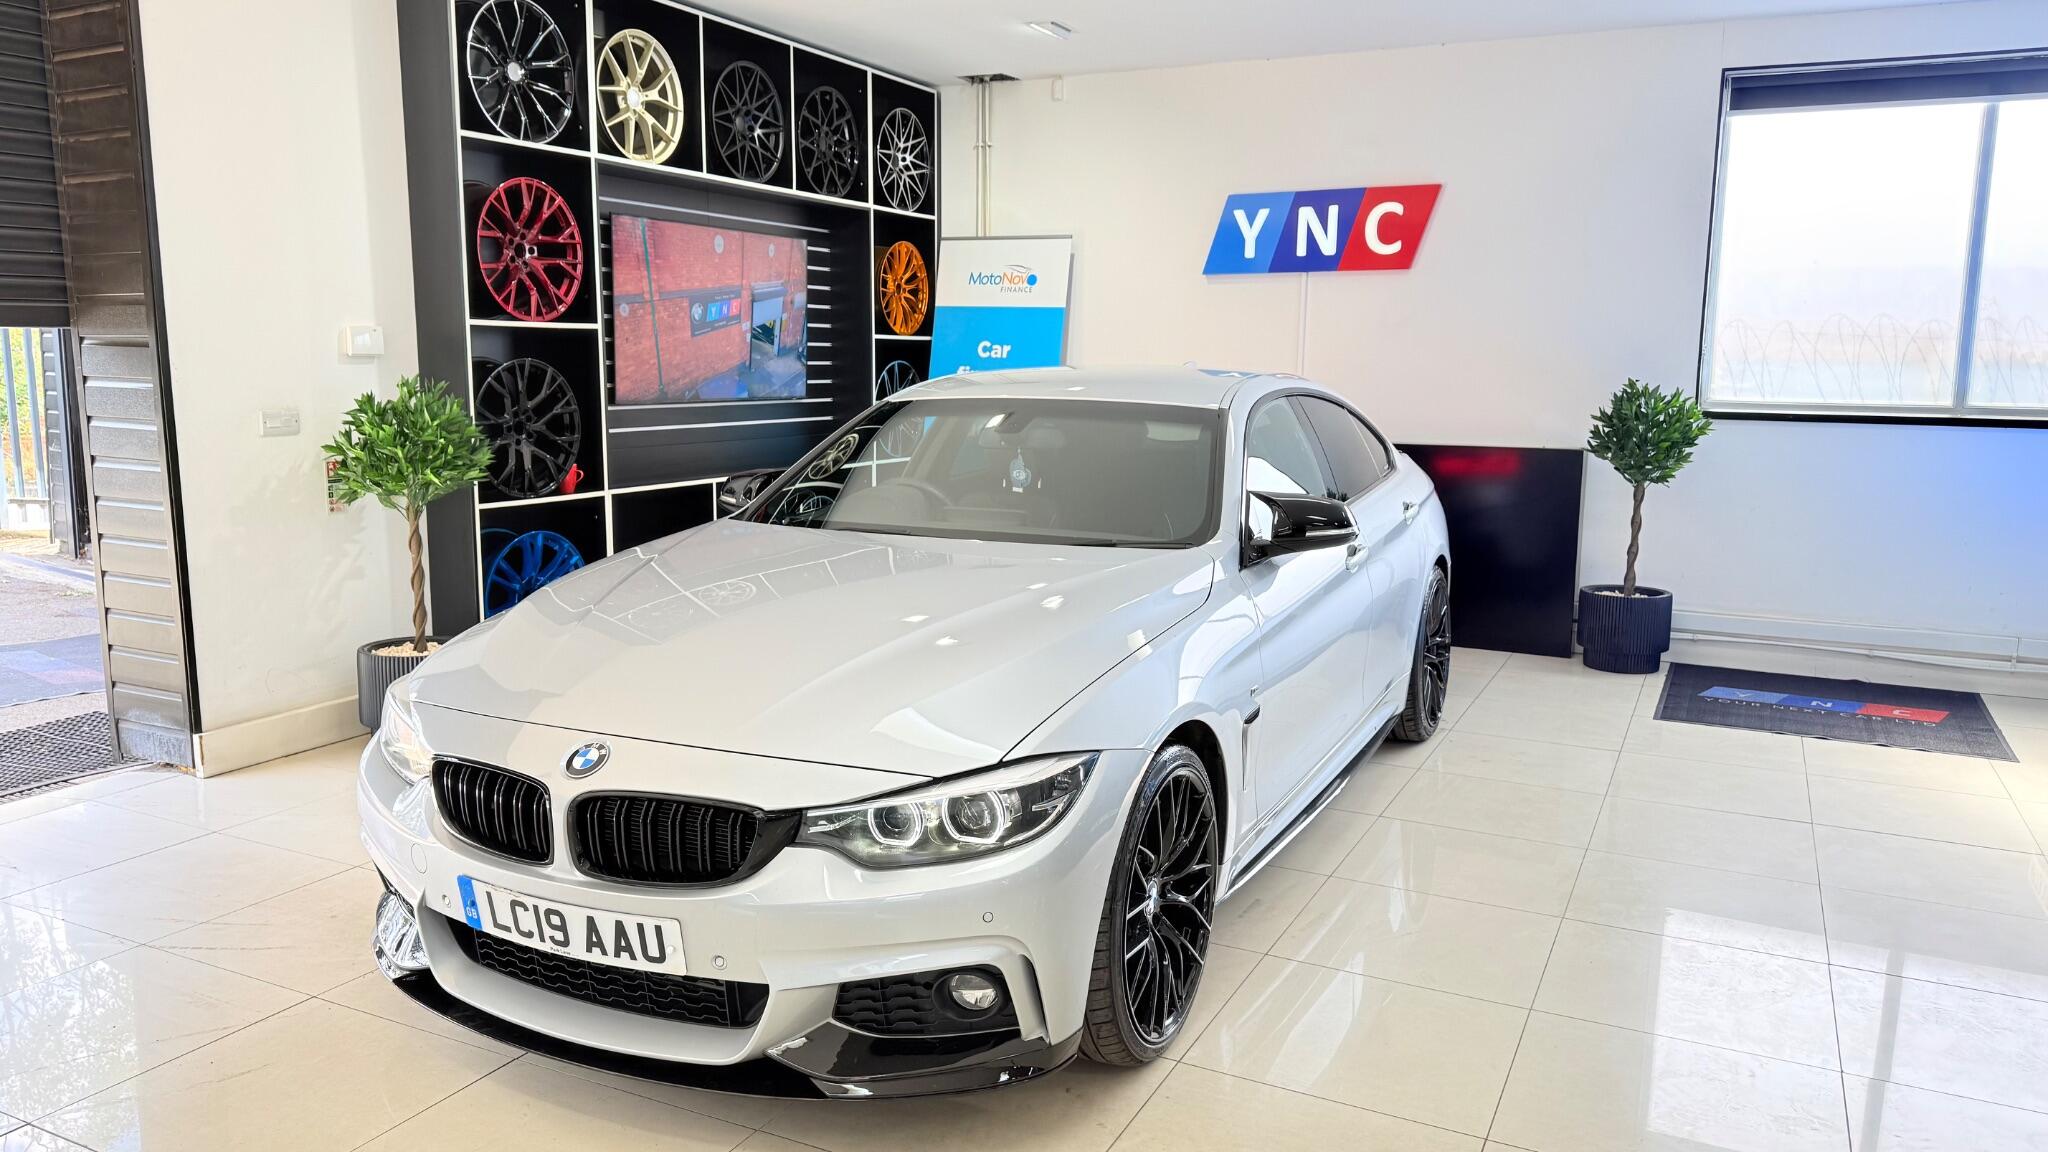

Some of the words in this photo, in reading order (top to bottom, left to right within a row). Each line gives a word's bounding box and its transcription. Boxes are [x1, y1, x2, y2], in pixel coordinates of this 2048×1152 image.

[1233, 201, 1404, 259] YNC
[968, 271, 1037, 286] MotoNovo
[977, 341, 1012, 358] Car
[1704, 697, 1760, 707] YOUR
[1773, 704, 1828, 714] NEXT
[1840, 713, 1882, 721] CAR
[466, 906, 478, 919] GB
[486, 891, 570, 948] LC19
[586, 915, 667, 964] AAU
